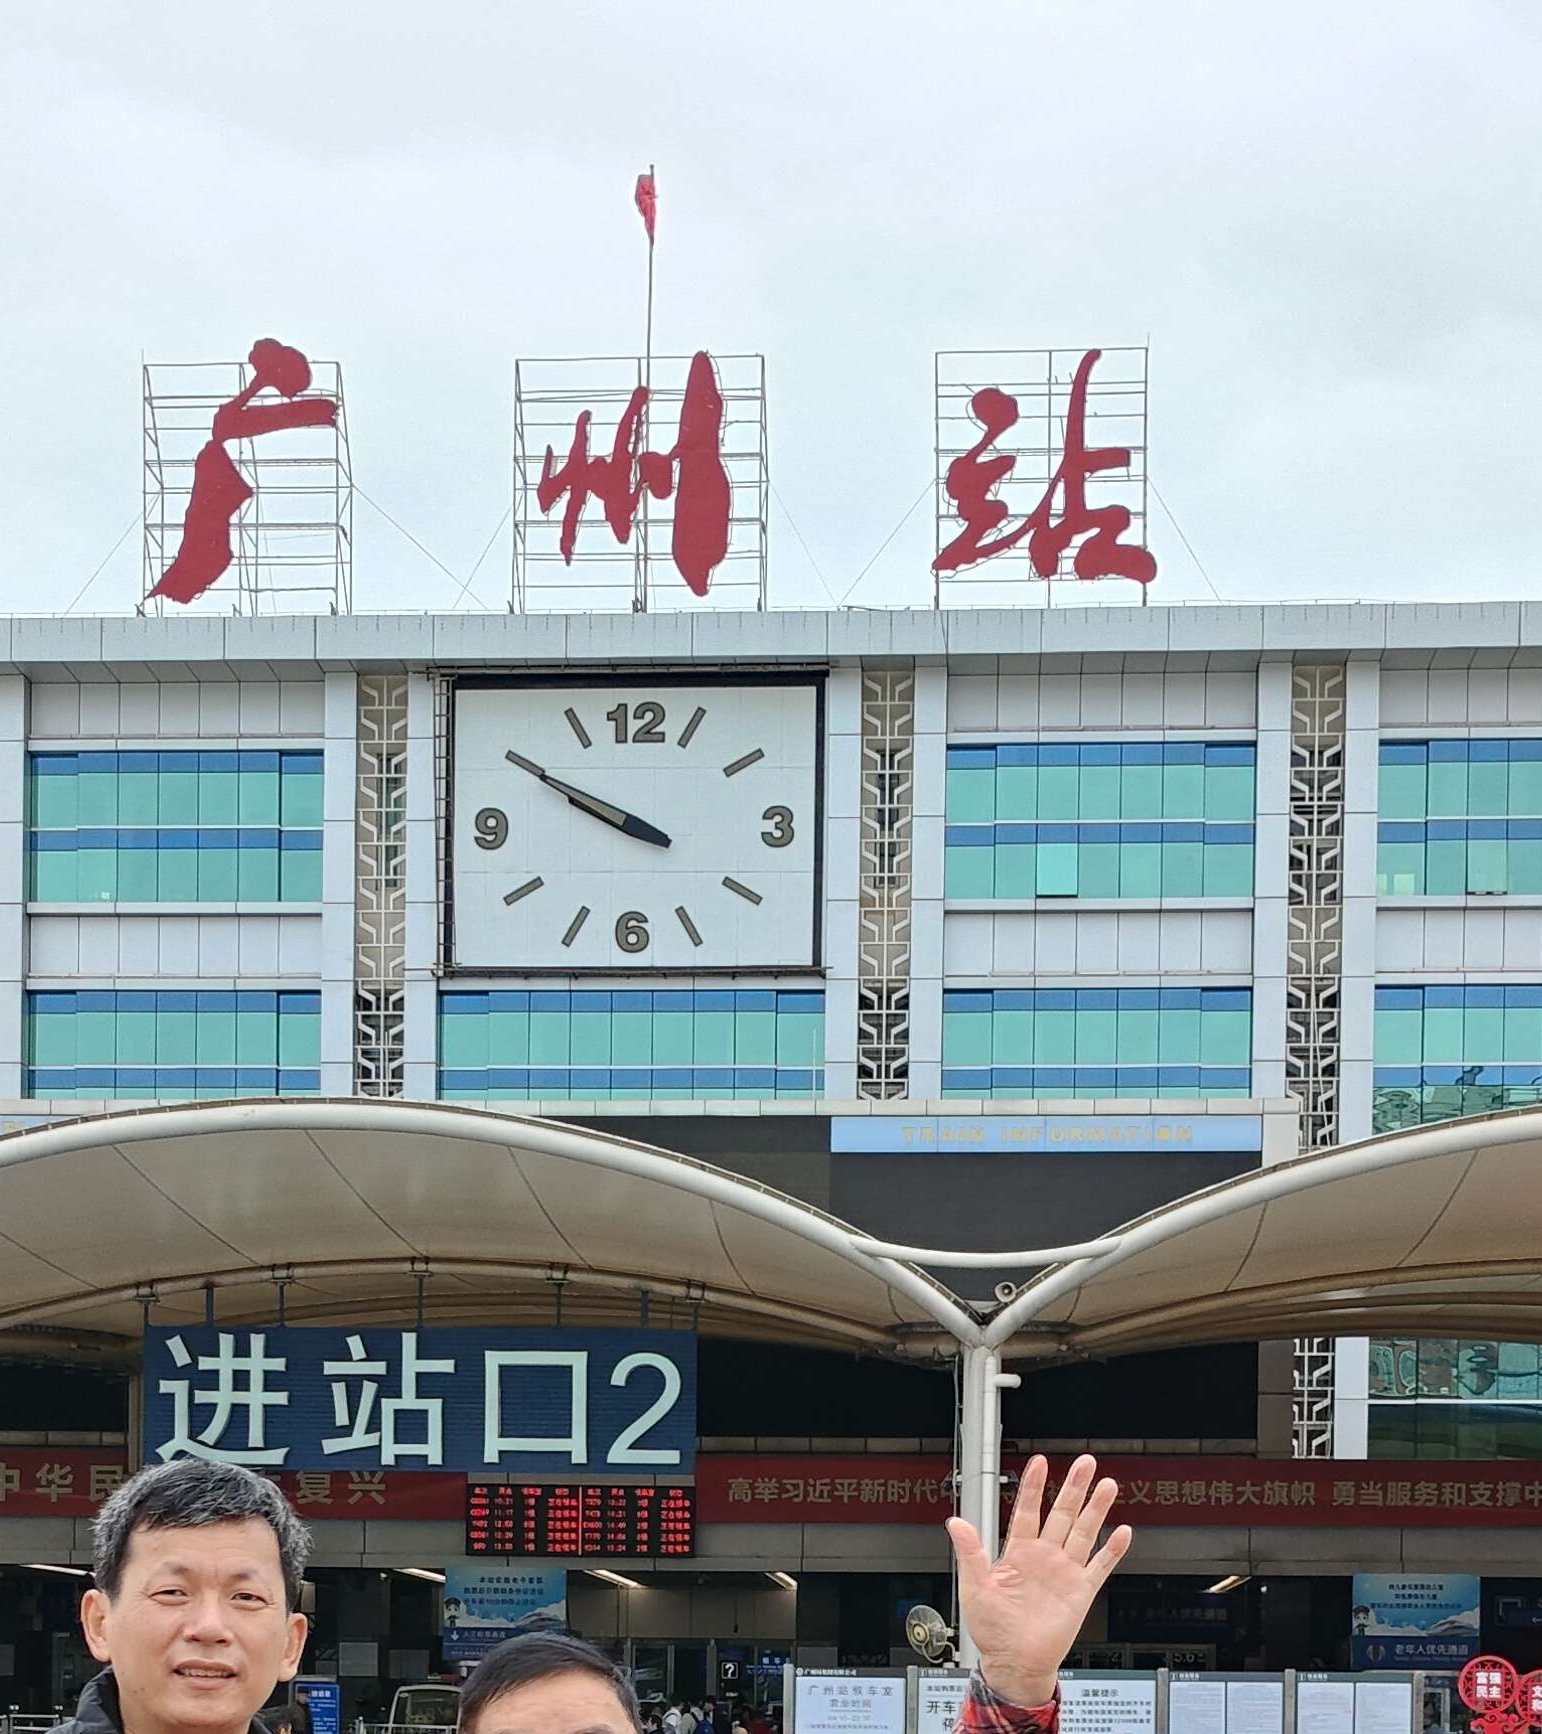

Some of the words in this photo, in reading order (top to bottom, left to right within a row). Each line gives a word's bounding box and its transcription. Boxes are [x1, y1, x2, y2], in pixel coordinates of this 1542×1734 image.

[149, 337, 1157, 604] 广州站
[607, 701, 666, 744] 12
[473, 807, 510, 850] 9
[760, 805, 796, 848] 3
[614, 910, 650, 953] 6
[156, 1332, 681, 1466] 进站口2
[1476, 1685, 1501, 1698] 民主
